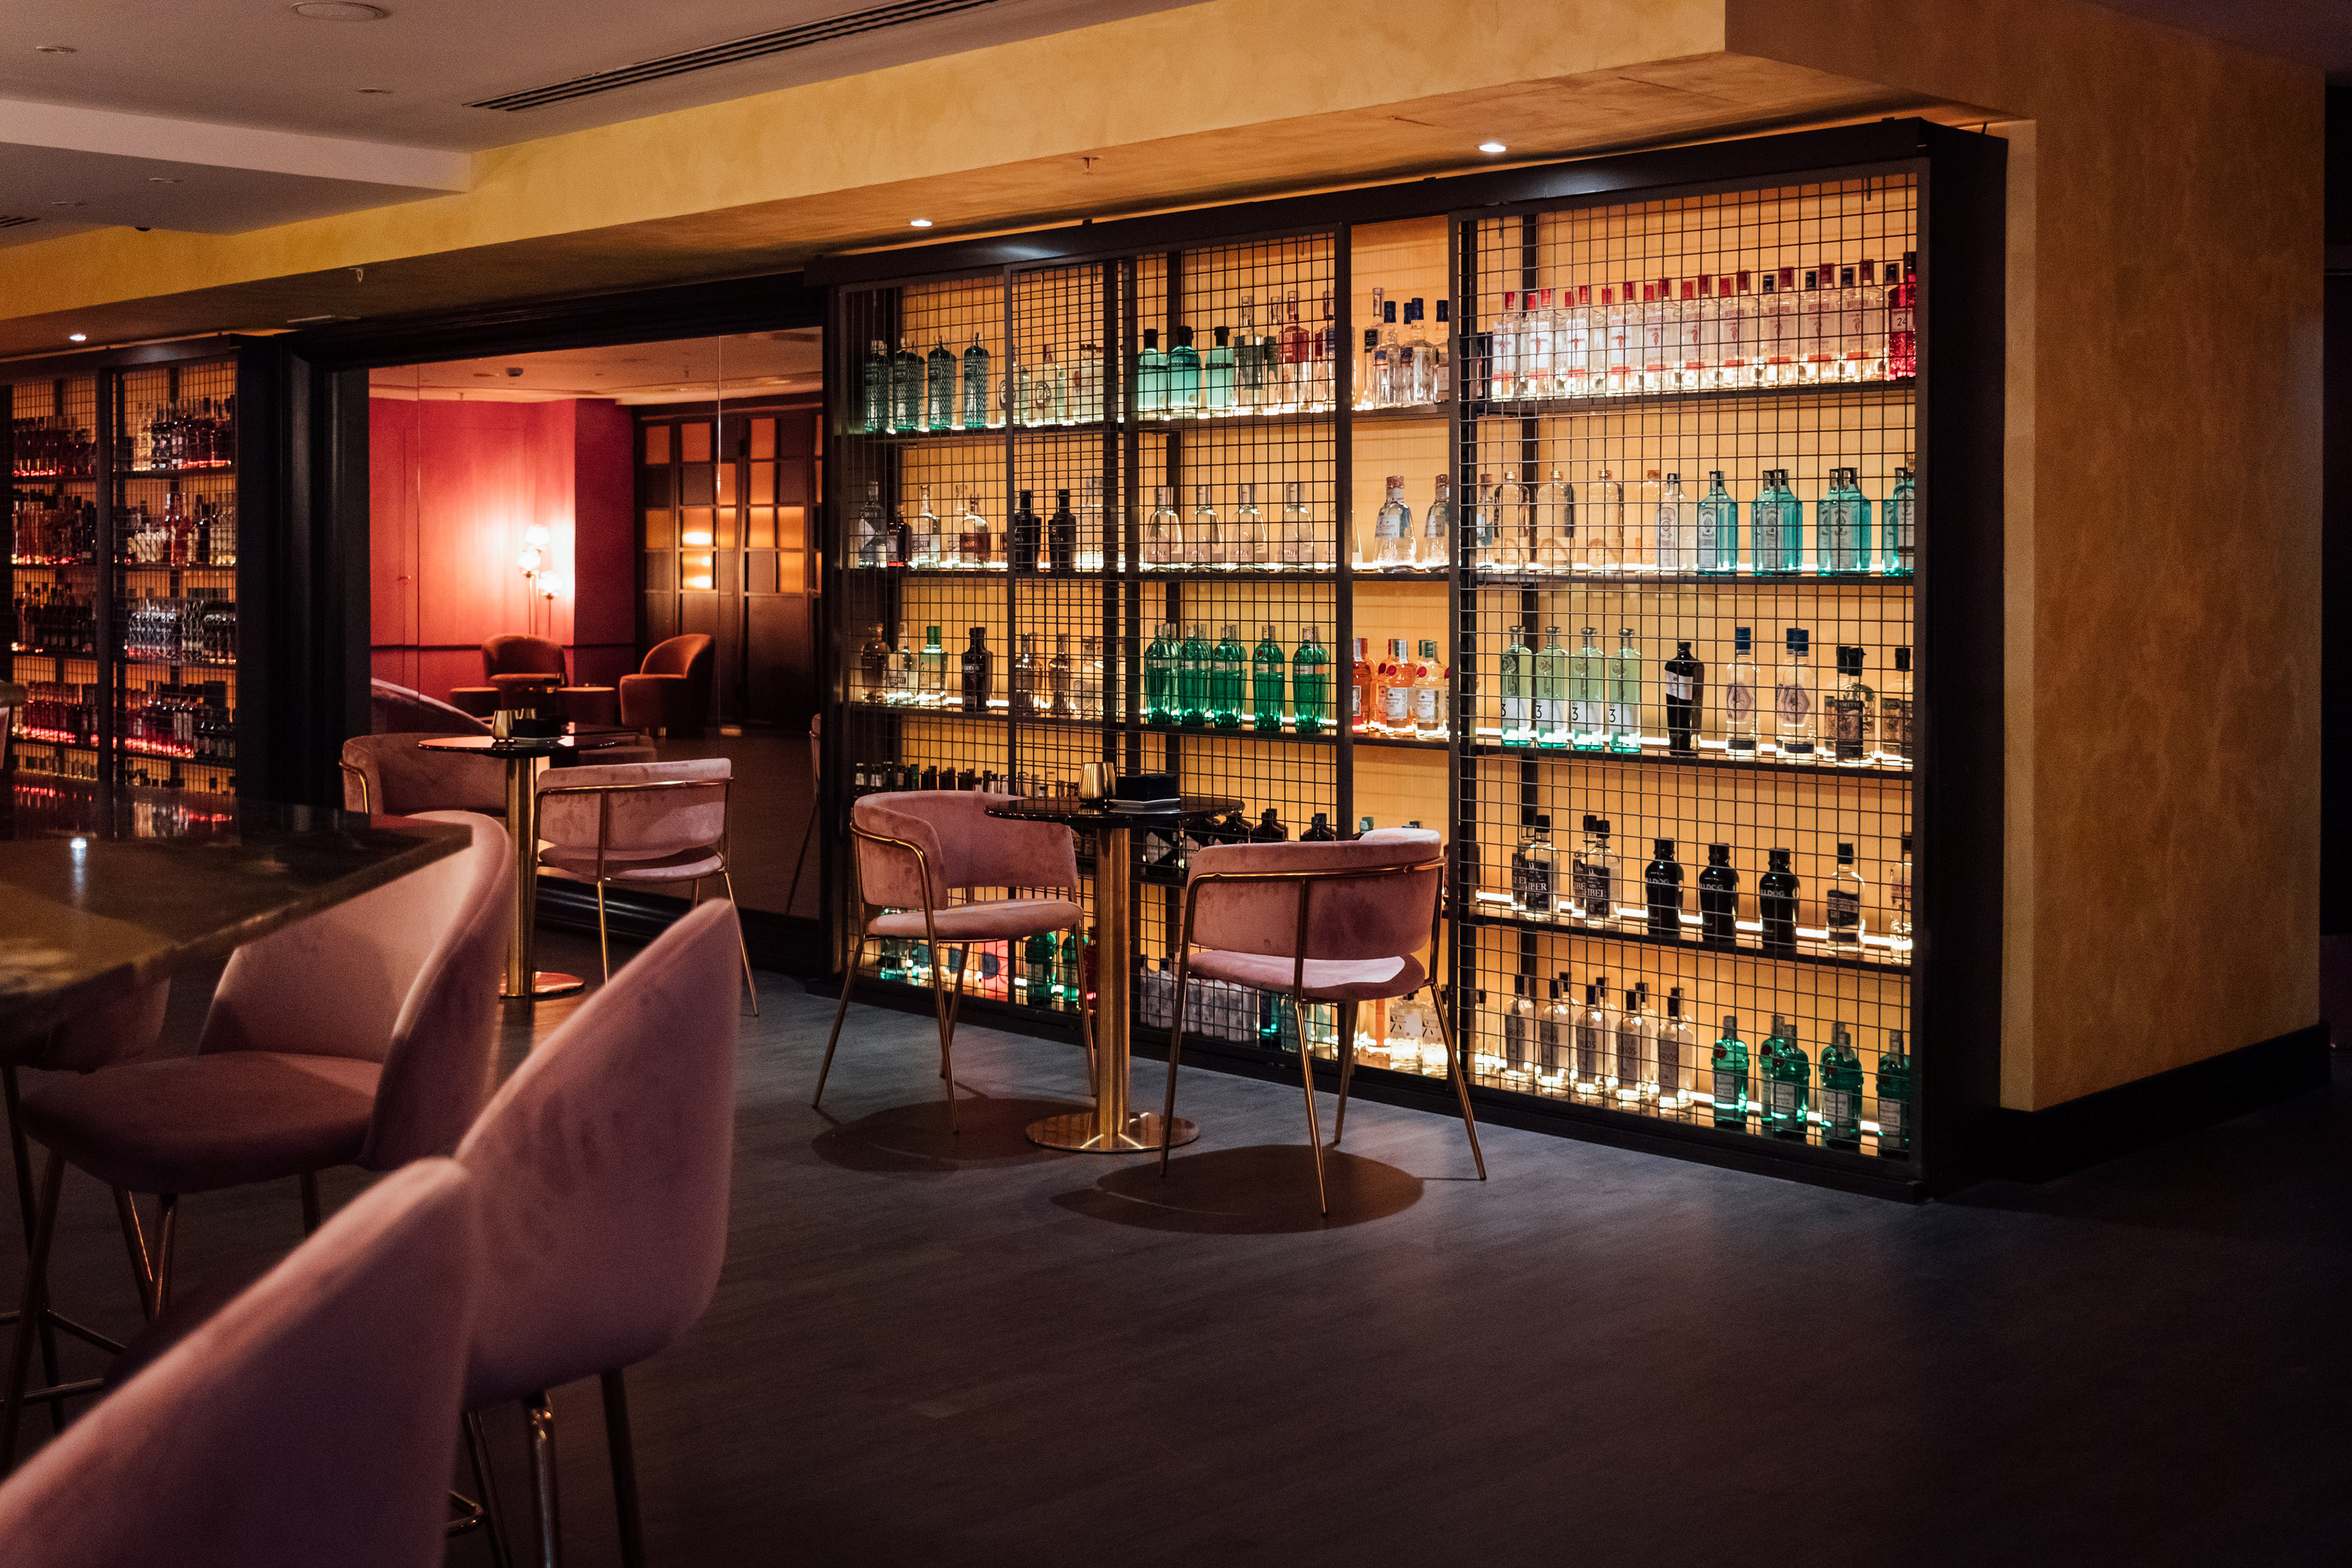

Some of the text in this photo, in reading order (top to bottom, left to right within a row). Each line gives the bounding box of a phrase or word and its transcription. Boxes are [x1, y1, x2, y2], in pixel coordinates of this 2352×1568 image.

[1847, 299, 1869, 309] BEEFEAER
[1725, 309, 1745, 318] BEEFEAER
[1768, 305, 1790, 315] BEEFATER
[1535, 705, 1542, 718] 3
[1571, 707, 1579, 721] 3
[1608, 709, 1616, 722] 3
